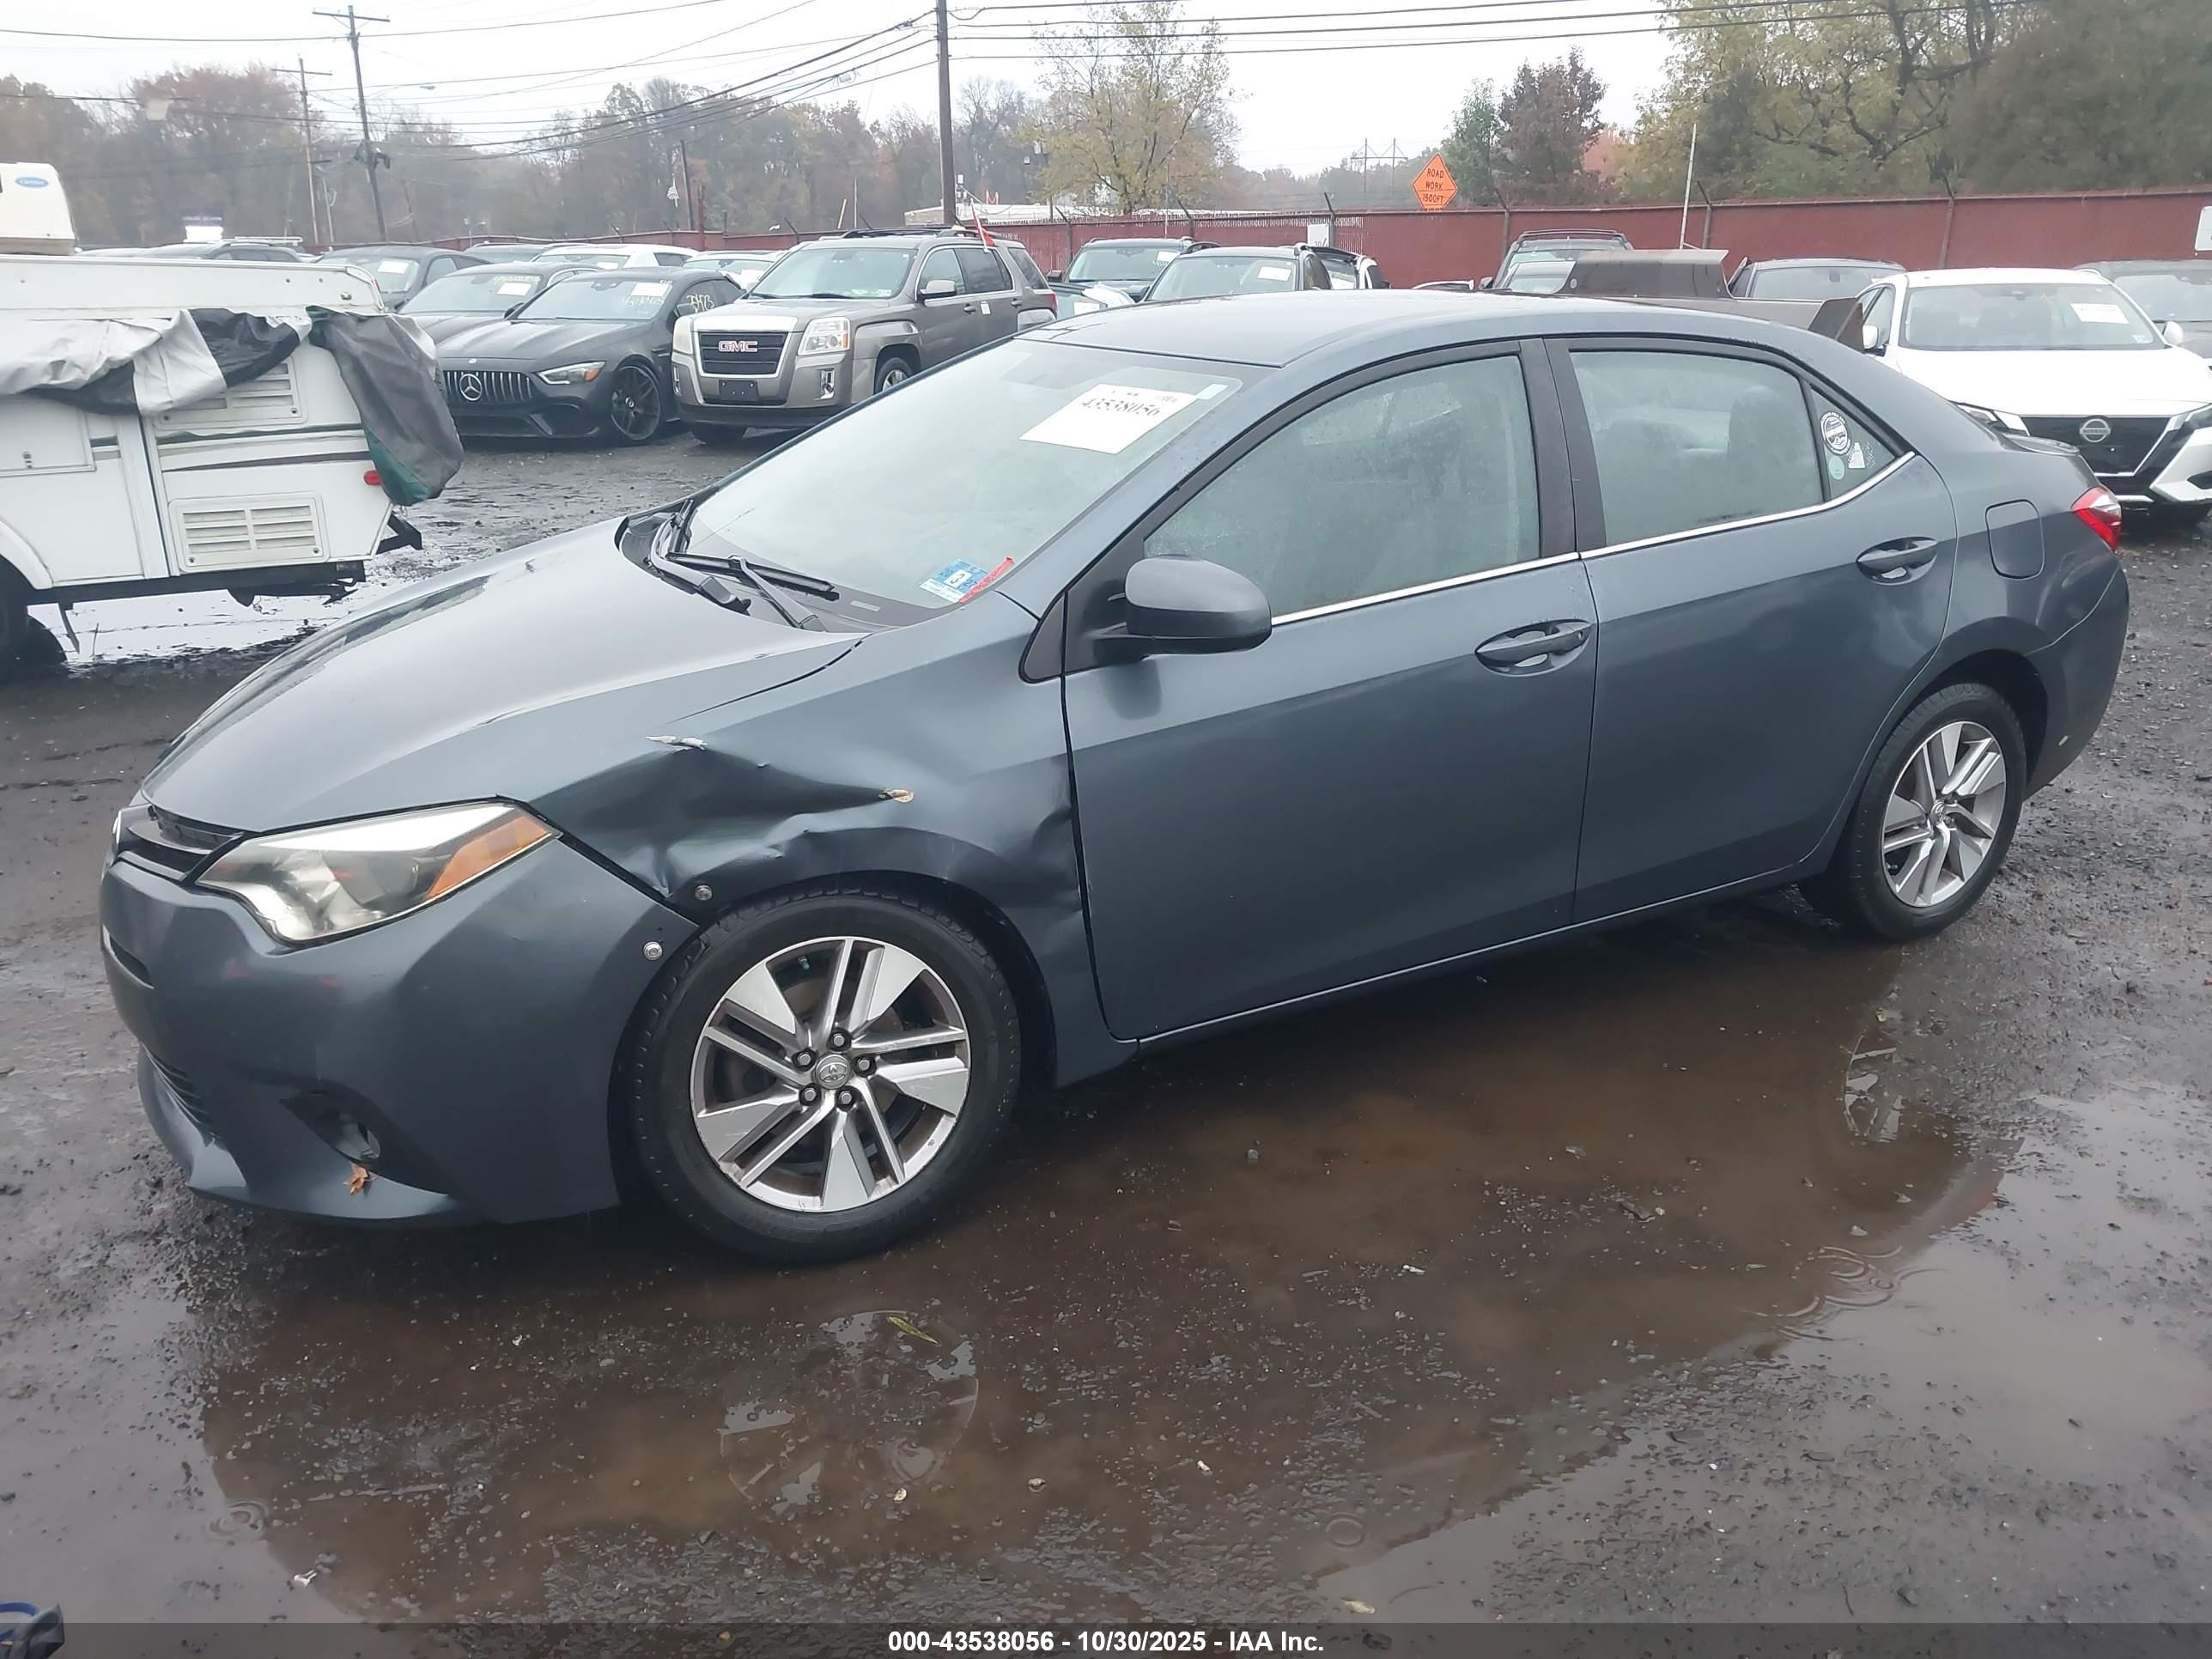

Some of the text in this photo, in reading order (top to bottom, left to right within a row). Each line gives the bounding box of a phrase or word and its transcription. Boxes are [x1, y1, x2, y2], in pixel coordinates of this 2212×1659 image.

[1426, 168, 1444, 179] ROAD
[1425, 181, 1443, 191] WORK
[718, 340, 758, 353] GMC
